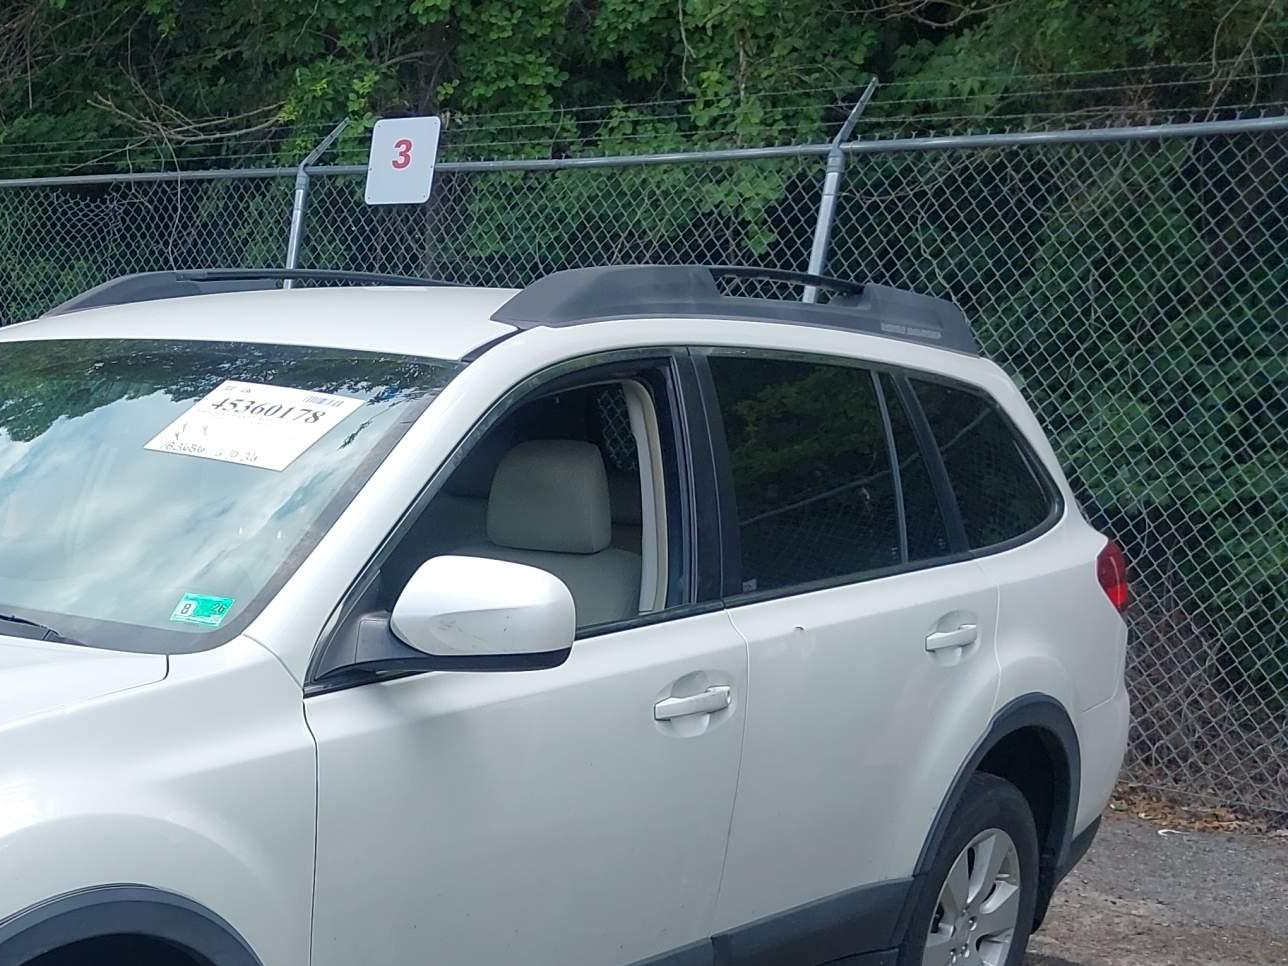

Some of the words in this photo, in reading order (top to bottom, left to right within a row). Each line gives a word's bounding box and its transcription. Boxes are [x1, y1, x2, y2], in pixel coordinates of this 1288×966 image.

[391, 139, 413, 169] 3
[211, 397, 326, 424] 45360178
[181, 603, 192, 614] 8
